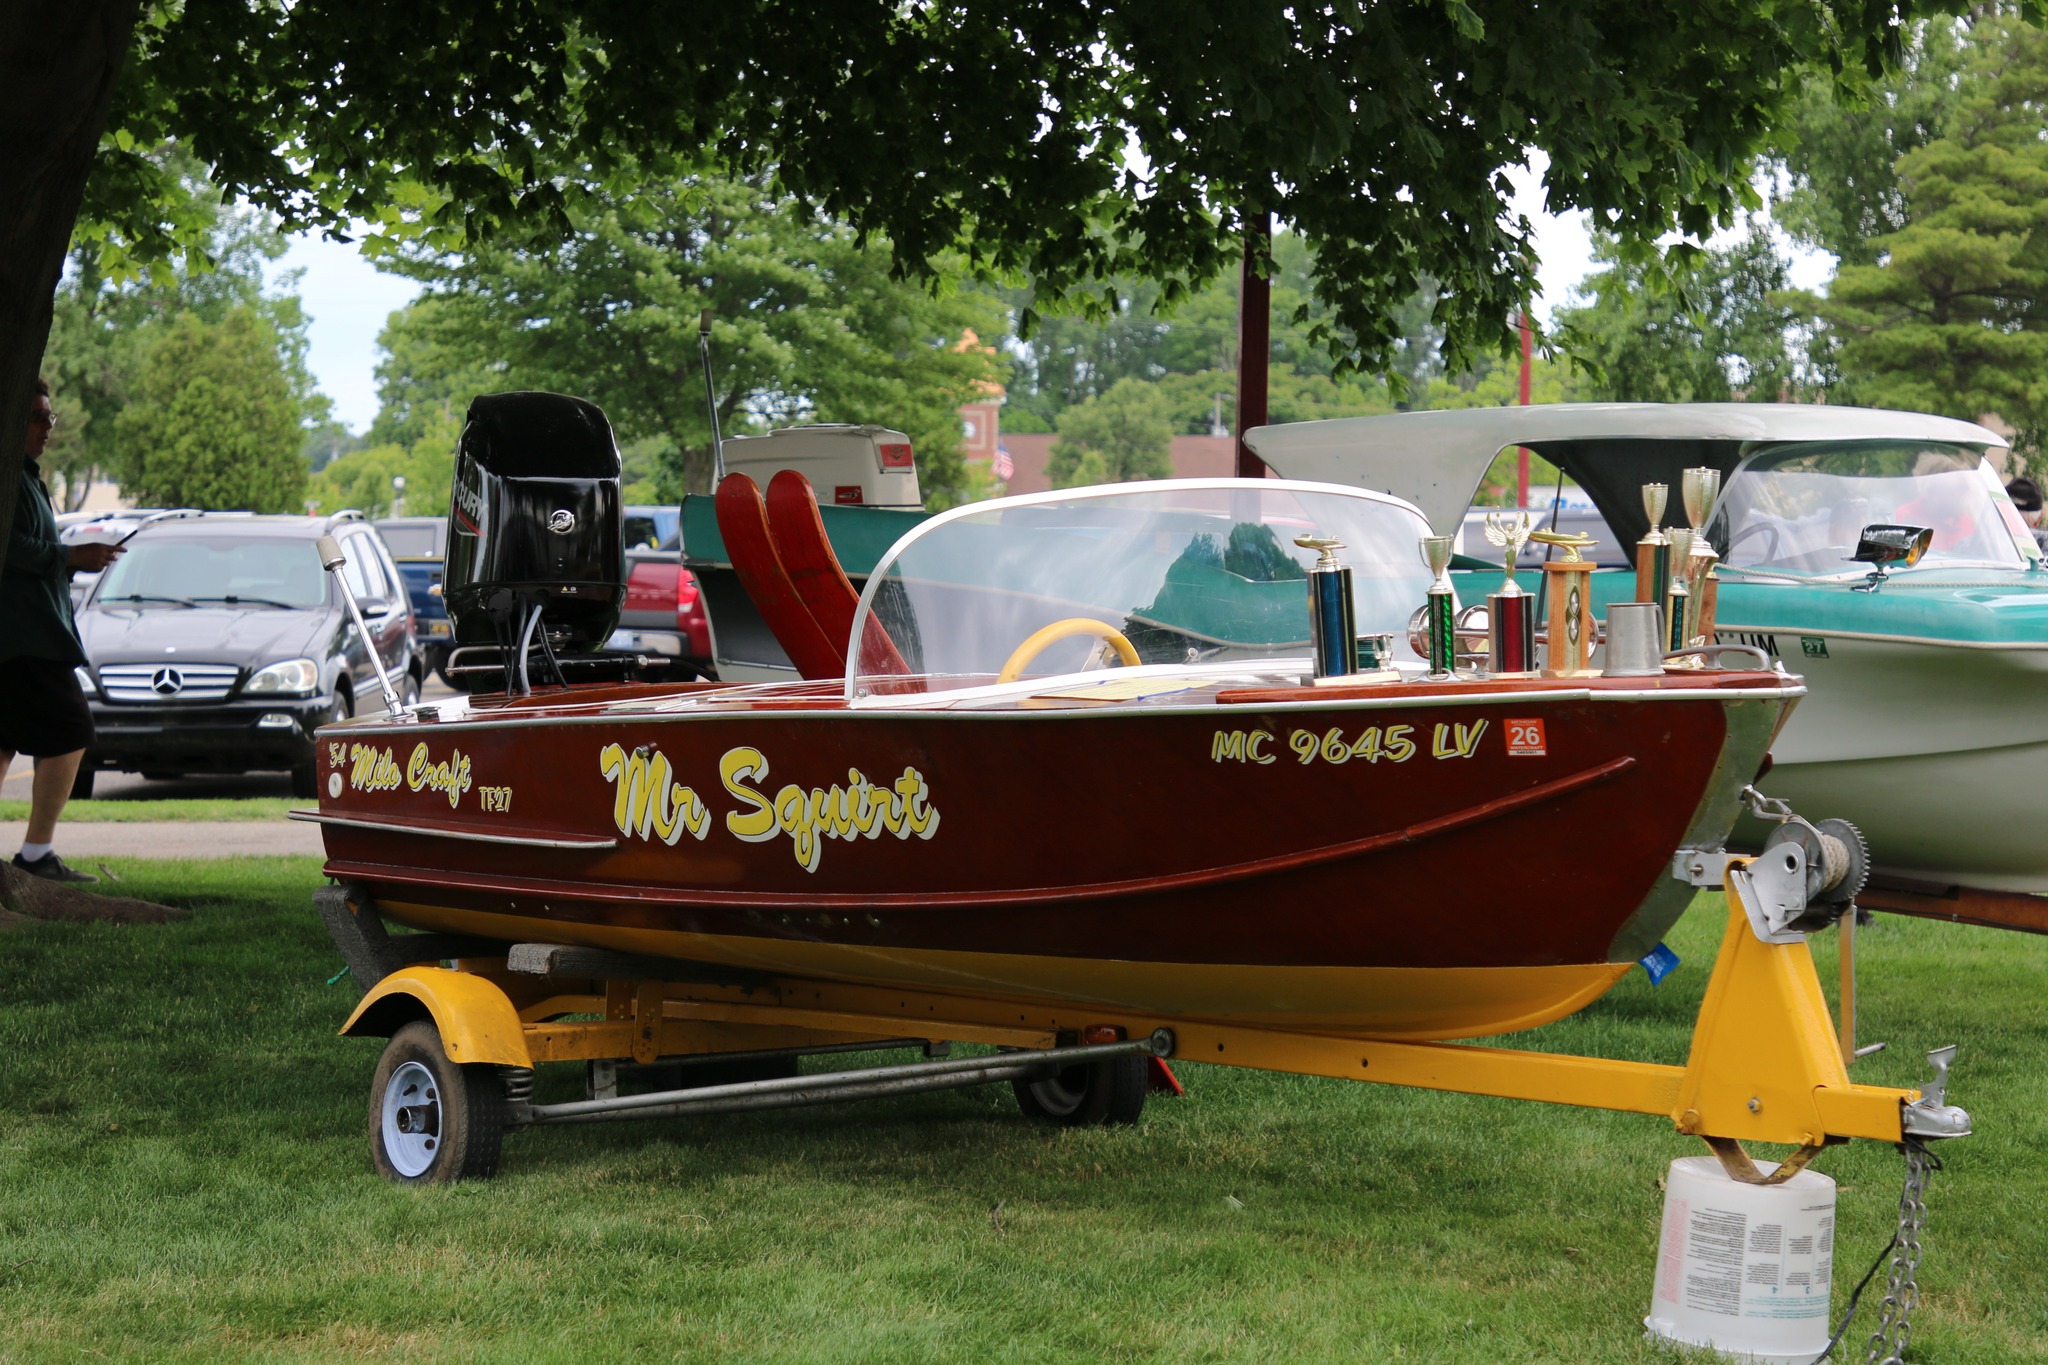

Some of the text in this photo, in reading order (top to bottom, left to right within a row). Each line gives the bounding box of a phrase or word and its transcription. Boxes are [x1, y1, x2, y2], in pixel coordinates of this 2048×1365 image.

[1804, 642, 1821, 653] 27
[1211, 718, 1490, 765] MC 9645 LV
[1510, 726, 1541, 746] 26
[350, 741, 472, 809] Milo Craft
[478, 786, 512, 813] TF27
[600, 742, 941, 873] Mr Squirt
